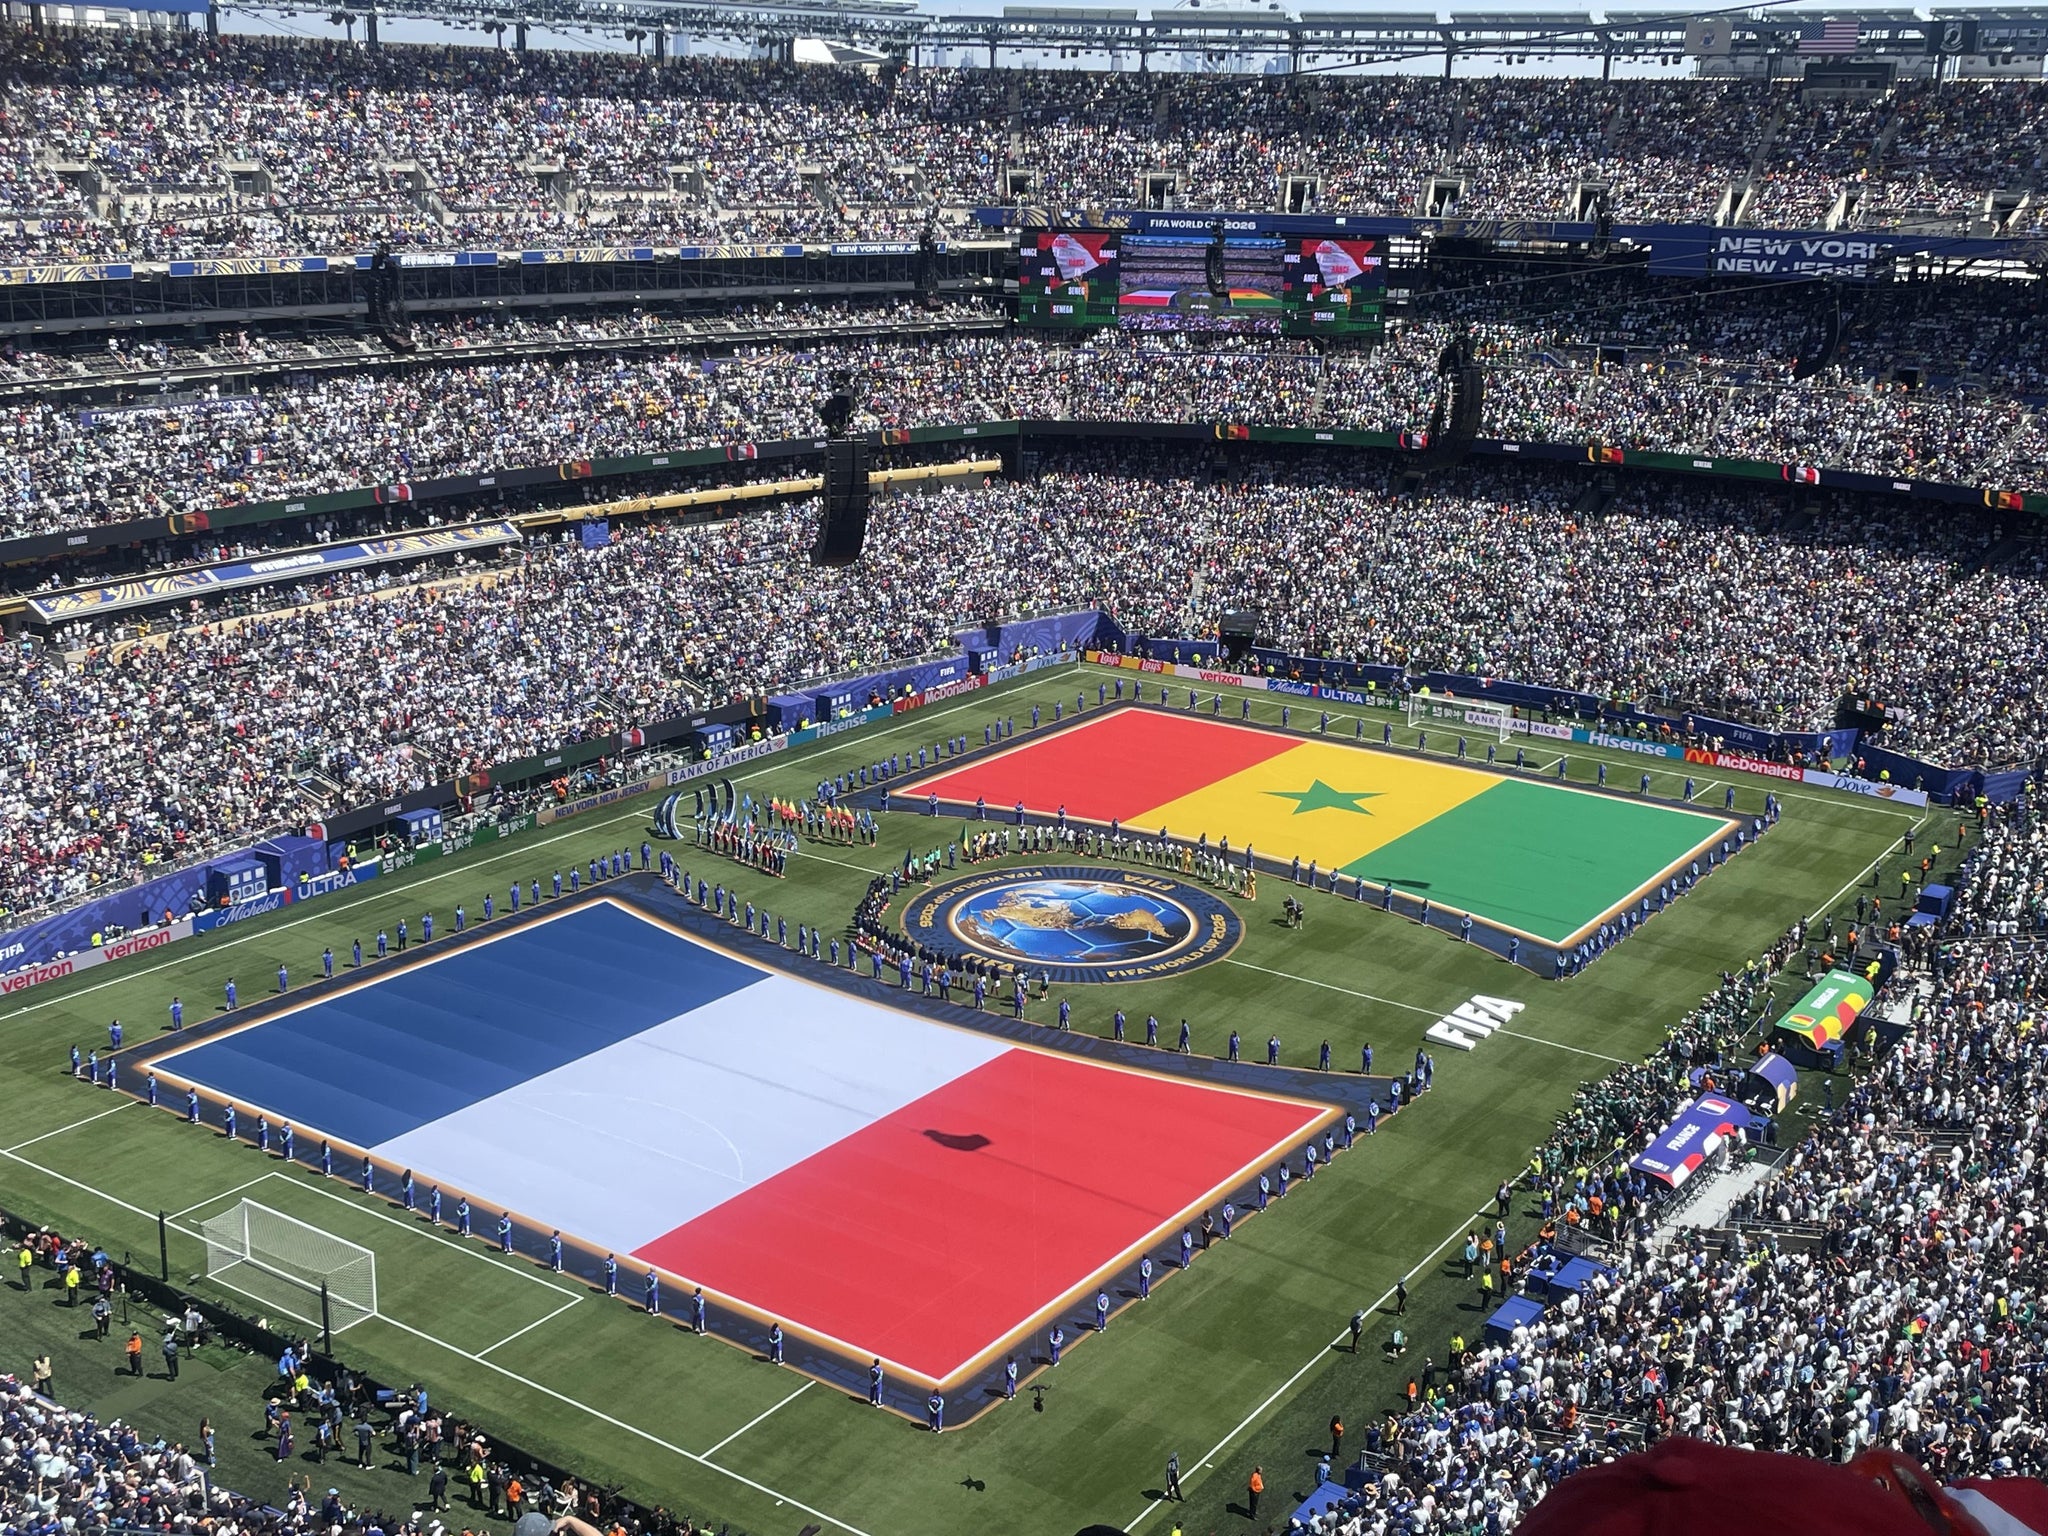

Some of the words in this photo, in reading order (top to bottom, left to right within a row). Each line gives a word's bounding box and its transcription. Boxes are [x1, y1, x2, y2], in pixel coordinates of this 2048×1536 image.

[1150, 219, 1170, 228] FIFA
[1170, 220, 1203, 229] WORLD
[1204, 220, 1222, 229] CU
[1223, 221, 1256, 230] 2026
[837, 245, 858, 254] NEW
[859, 245, 884, 253] YORK
[885, 244, 907, 253] NEW
[1719, 236, 1792, 256] NEW
[1717, 257, 1777, 273] NEW
[1782, 260, 1868, 278] JERSE
[940, 666, 955, 677] FIFA
[1266, 657, 1284, 667] FIFA
[1199, 670, 1242, 686] verizon
[923, 678, 981, 705] McDonald's
[1268, 678, 1310, 697] Michelob
[1321, 690, 1363, 705] ULTRA
[816, 714, 868, 739] Hisense
[1468, 713, 1495, 725] BANK
[1589, 730, 1668, 757] Hisense
[1733, 729, 1753, 742] FIFA
[671, 765, 704, 783] BANK
[706, 759, 721, 772] OF
[723, 744, 773, 767] AMERICA
[1716, 754, 1801, 780] McDonald's
[1833, 776, 1871, 795] Dove
[555, 805, 575, 819] NEW
[575, 798, 599, 813] YORK
[599, 791, 618, 805] NEW
[619, 780, 650, 799] JERSEY
[1124, 874, 1176, 891] FIFA
[216, 894, 280, 928] Michelob
[297, 870, 358, 900] ULTRA
[0, 942, 25, 961] FIFA
[1106, 967, 1151, 978] FIFA
[1149, 951, 1204, 972] WORLD
[1200, 939, 1220, 953] CUP
[1211, 914, 1227, 939] 2026
[0, 960, 73, 993] verizon
[104, 930, 171, 961] verizon
[1425, 994, 1526, 1052] FIFA
[1666, 1123, 1700, 1152] FRANCE
